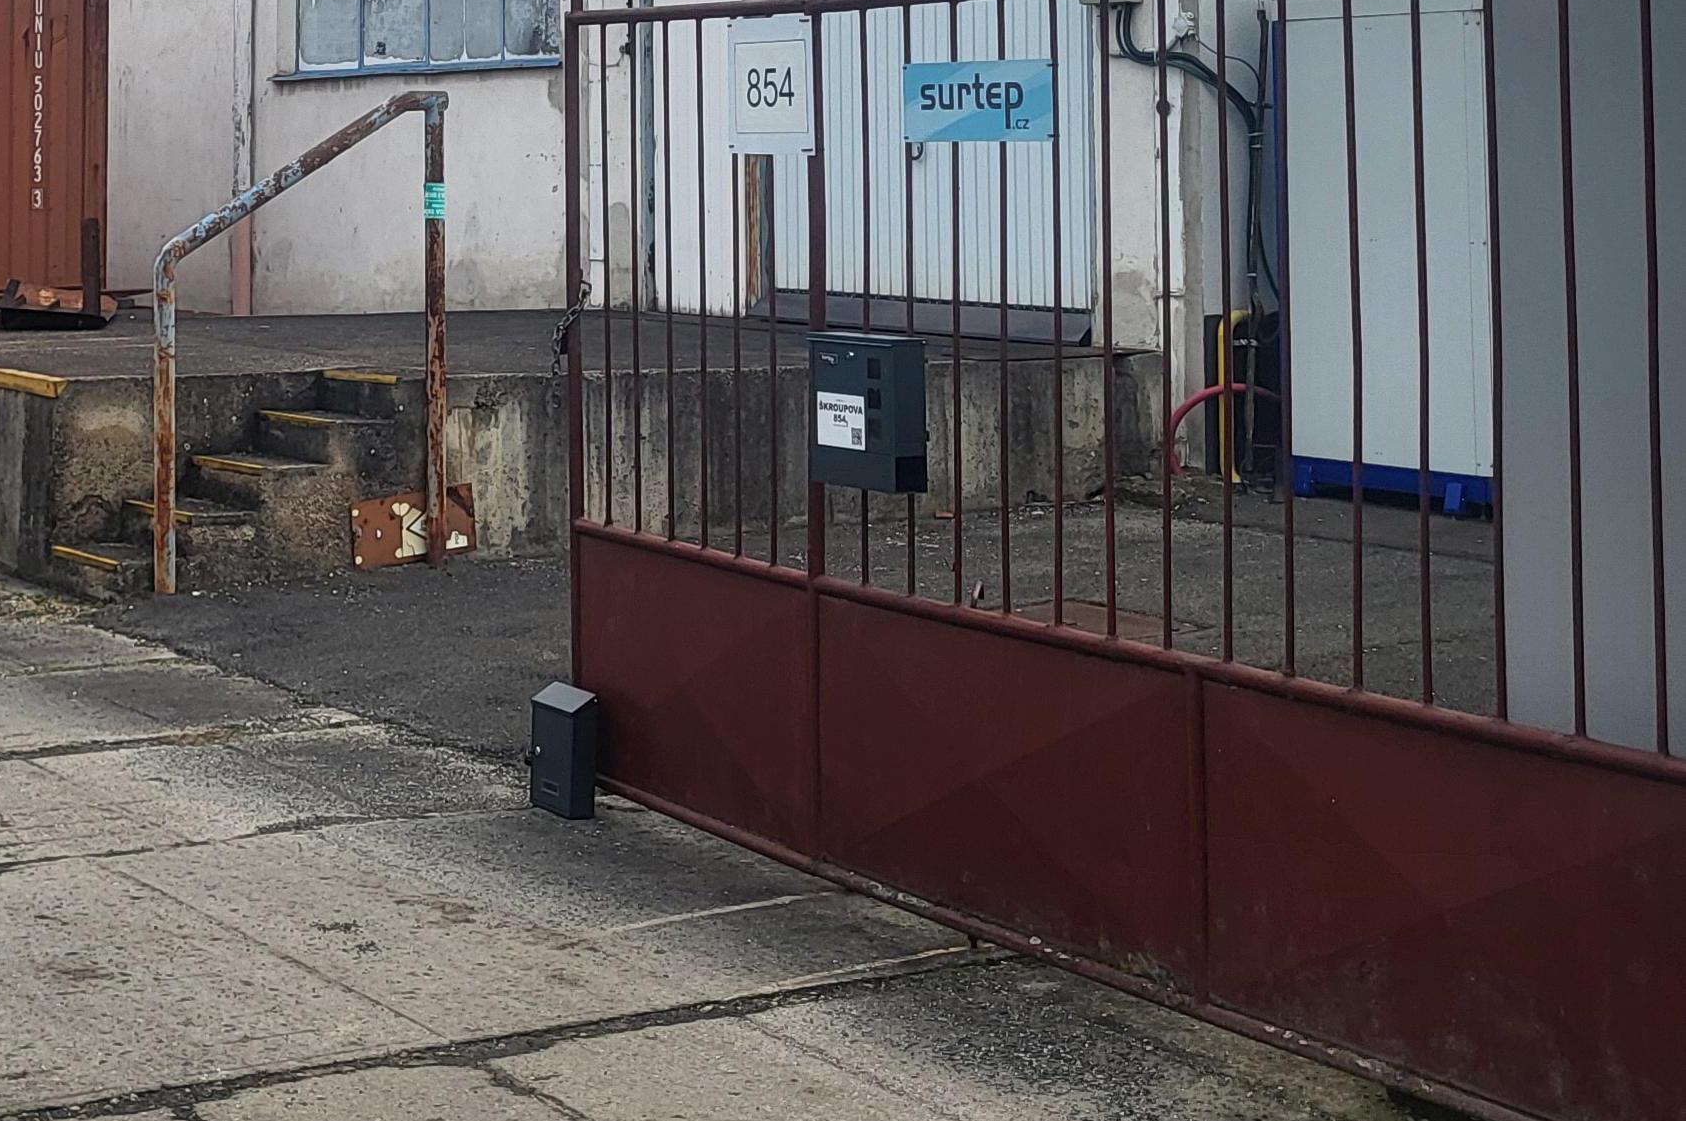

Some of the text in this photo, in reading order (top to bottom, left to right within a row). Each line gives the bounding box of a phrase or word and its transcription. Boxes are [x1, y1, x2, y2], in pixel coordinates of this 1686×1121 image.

[746, 67, 795, 108] 854
[33, 75, 44, 183] 502763
[32, 190, 43, 208] 3
